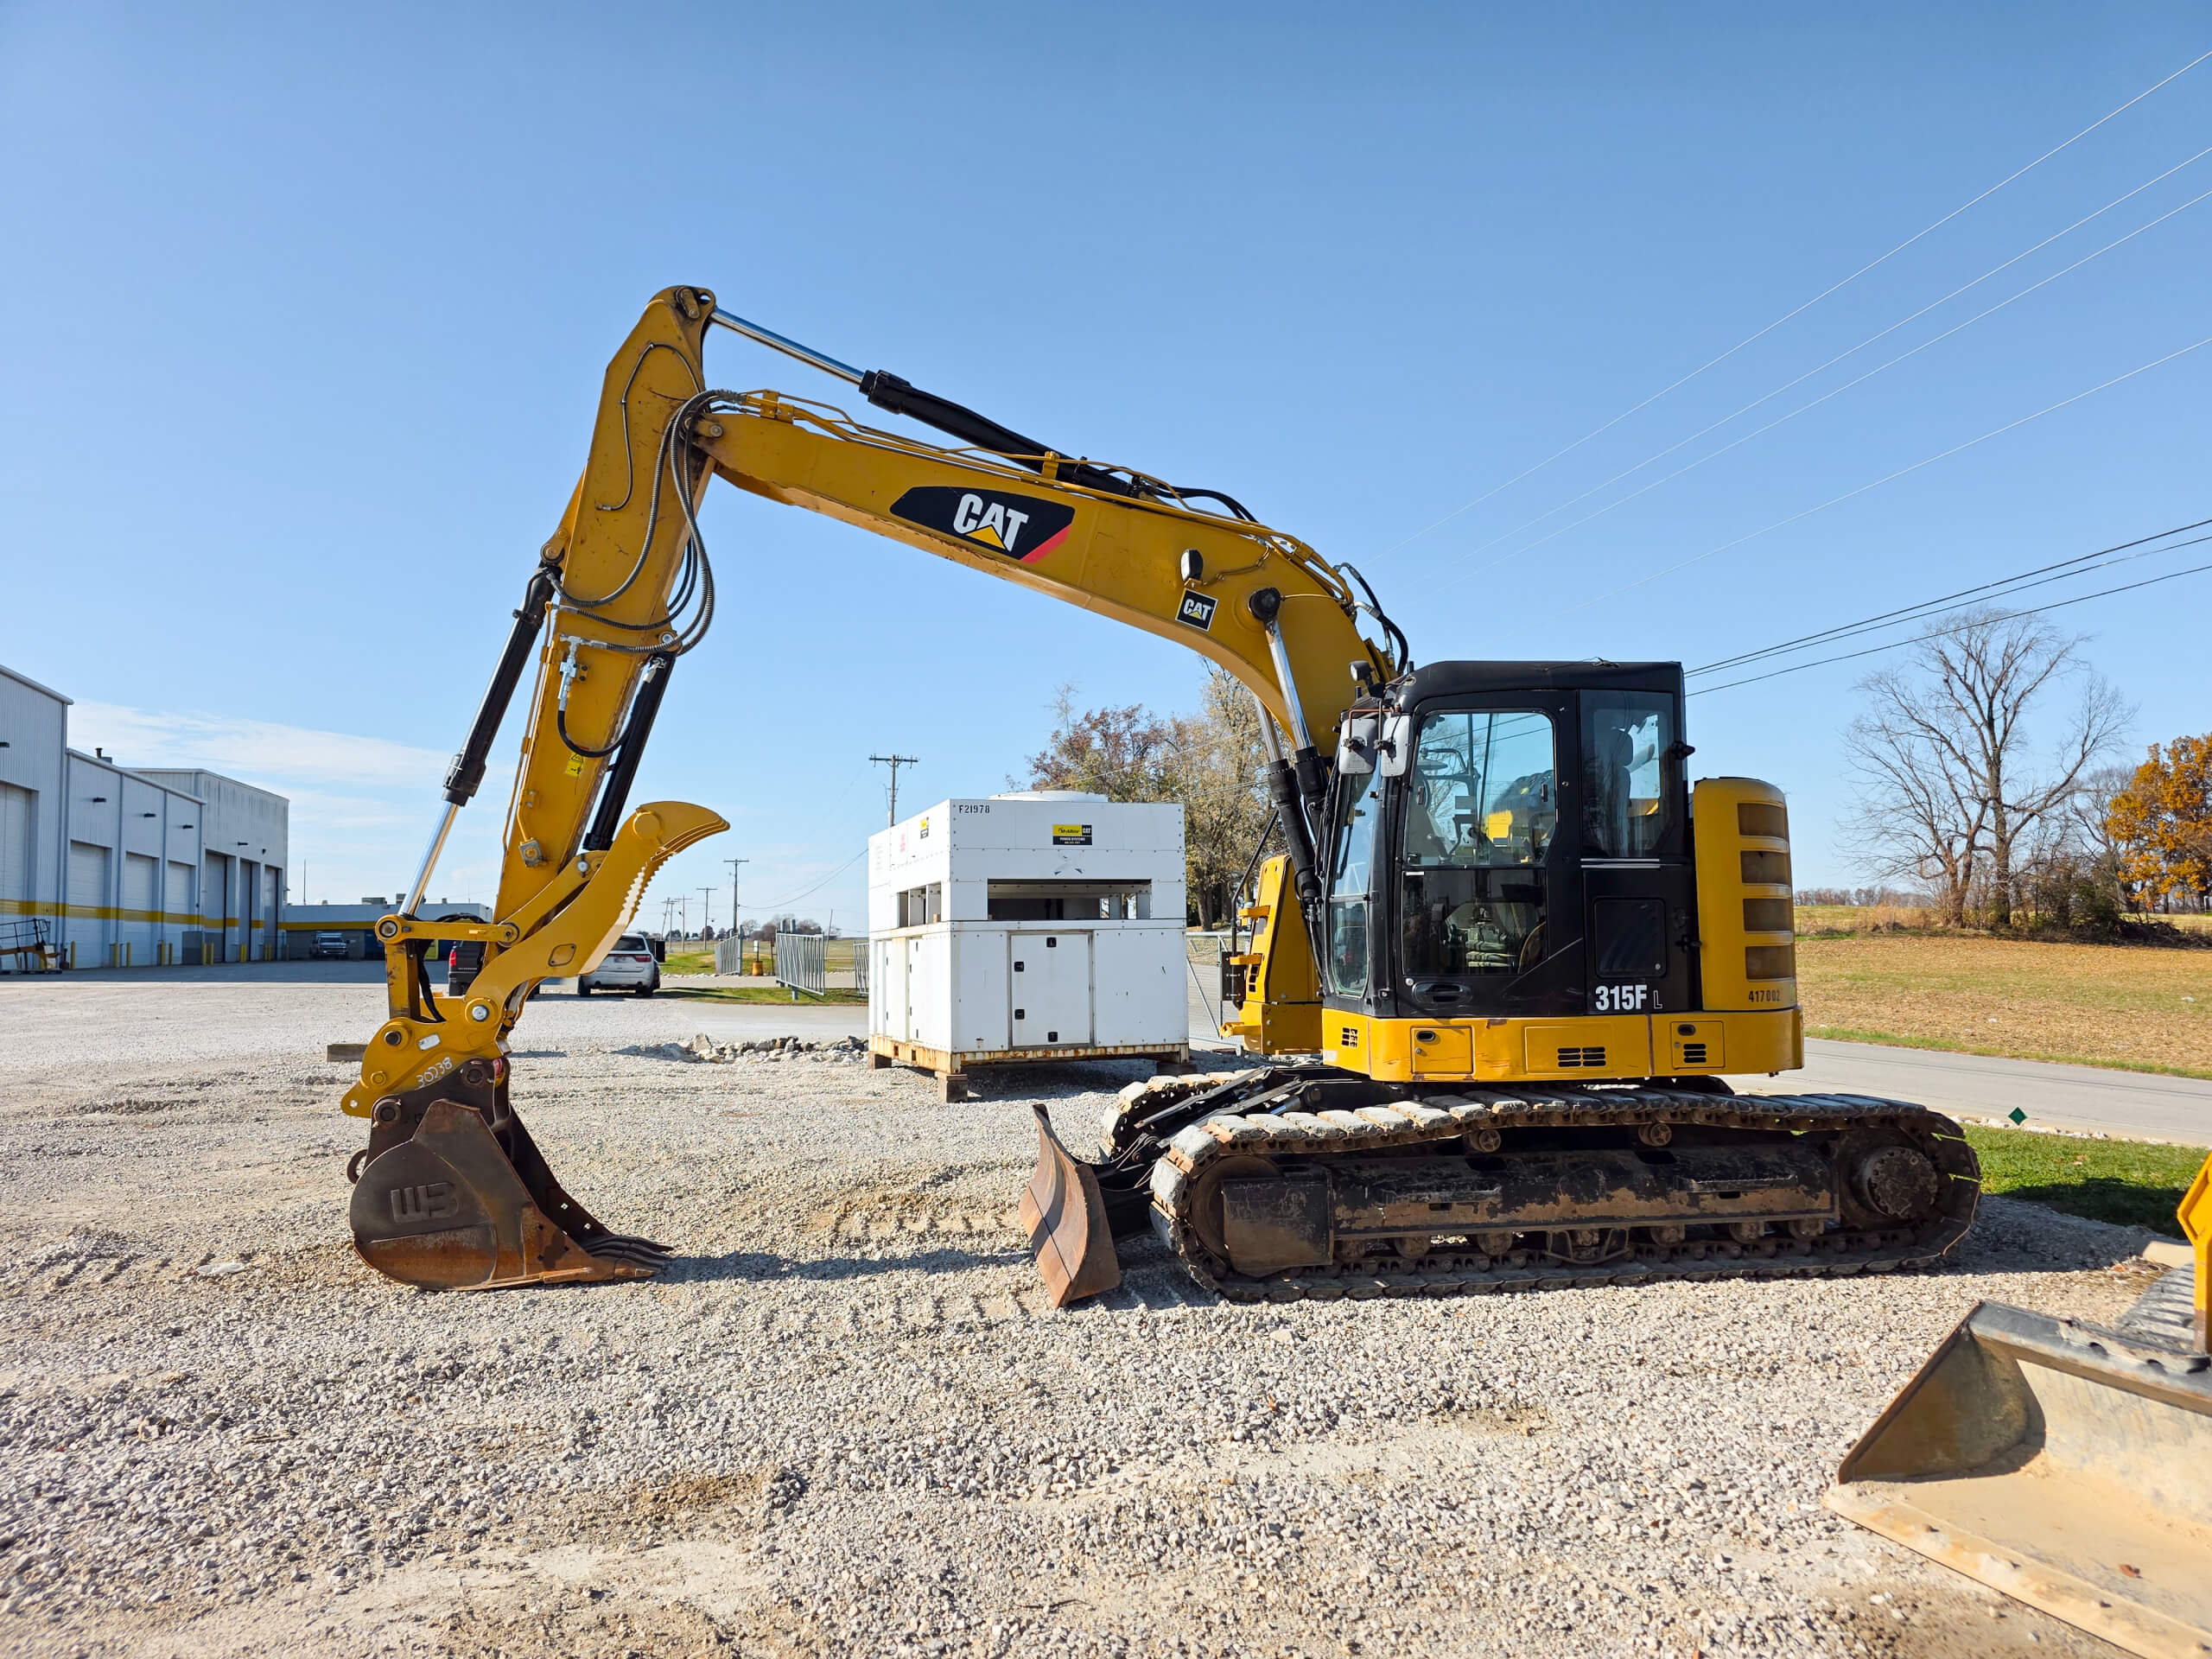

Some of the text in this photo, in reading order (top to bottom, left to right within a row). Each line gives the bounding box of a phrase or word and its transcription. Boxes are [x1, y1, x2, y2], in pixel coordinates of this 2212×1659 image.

[953, 493, 1029, 552] CAT
[1183, 598, 1211, 621] CAT
[958, 804, 990, 814] F21978
[1595, 984, 1663, 1011] 315F L
